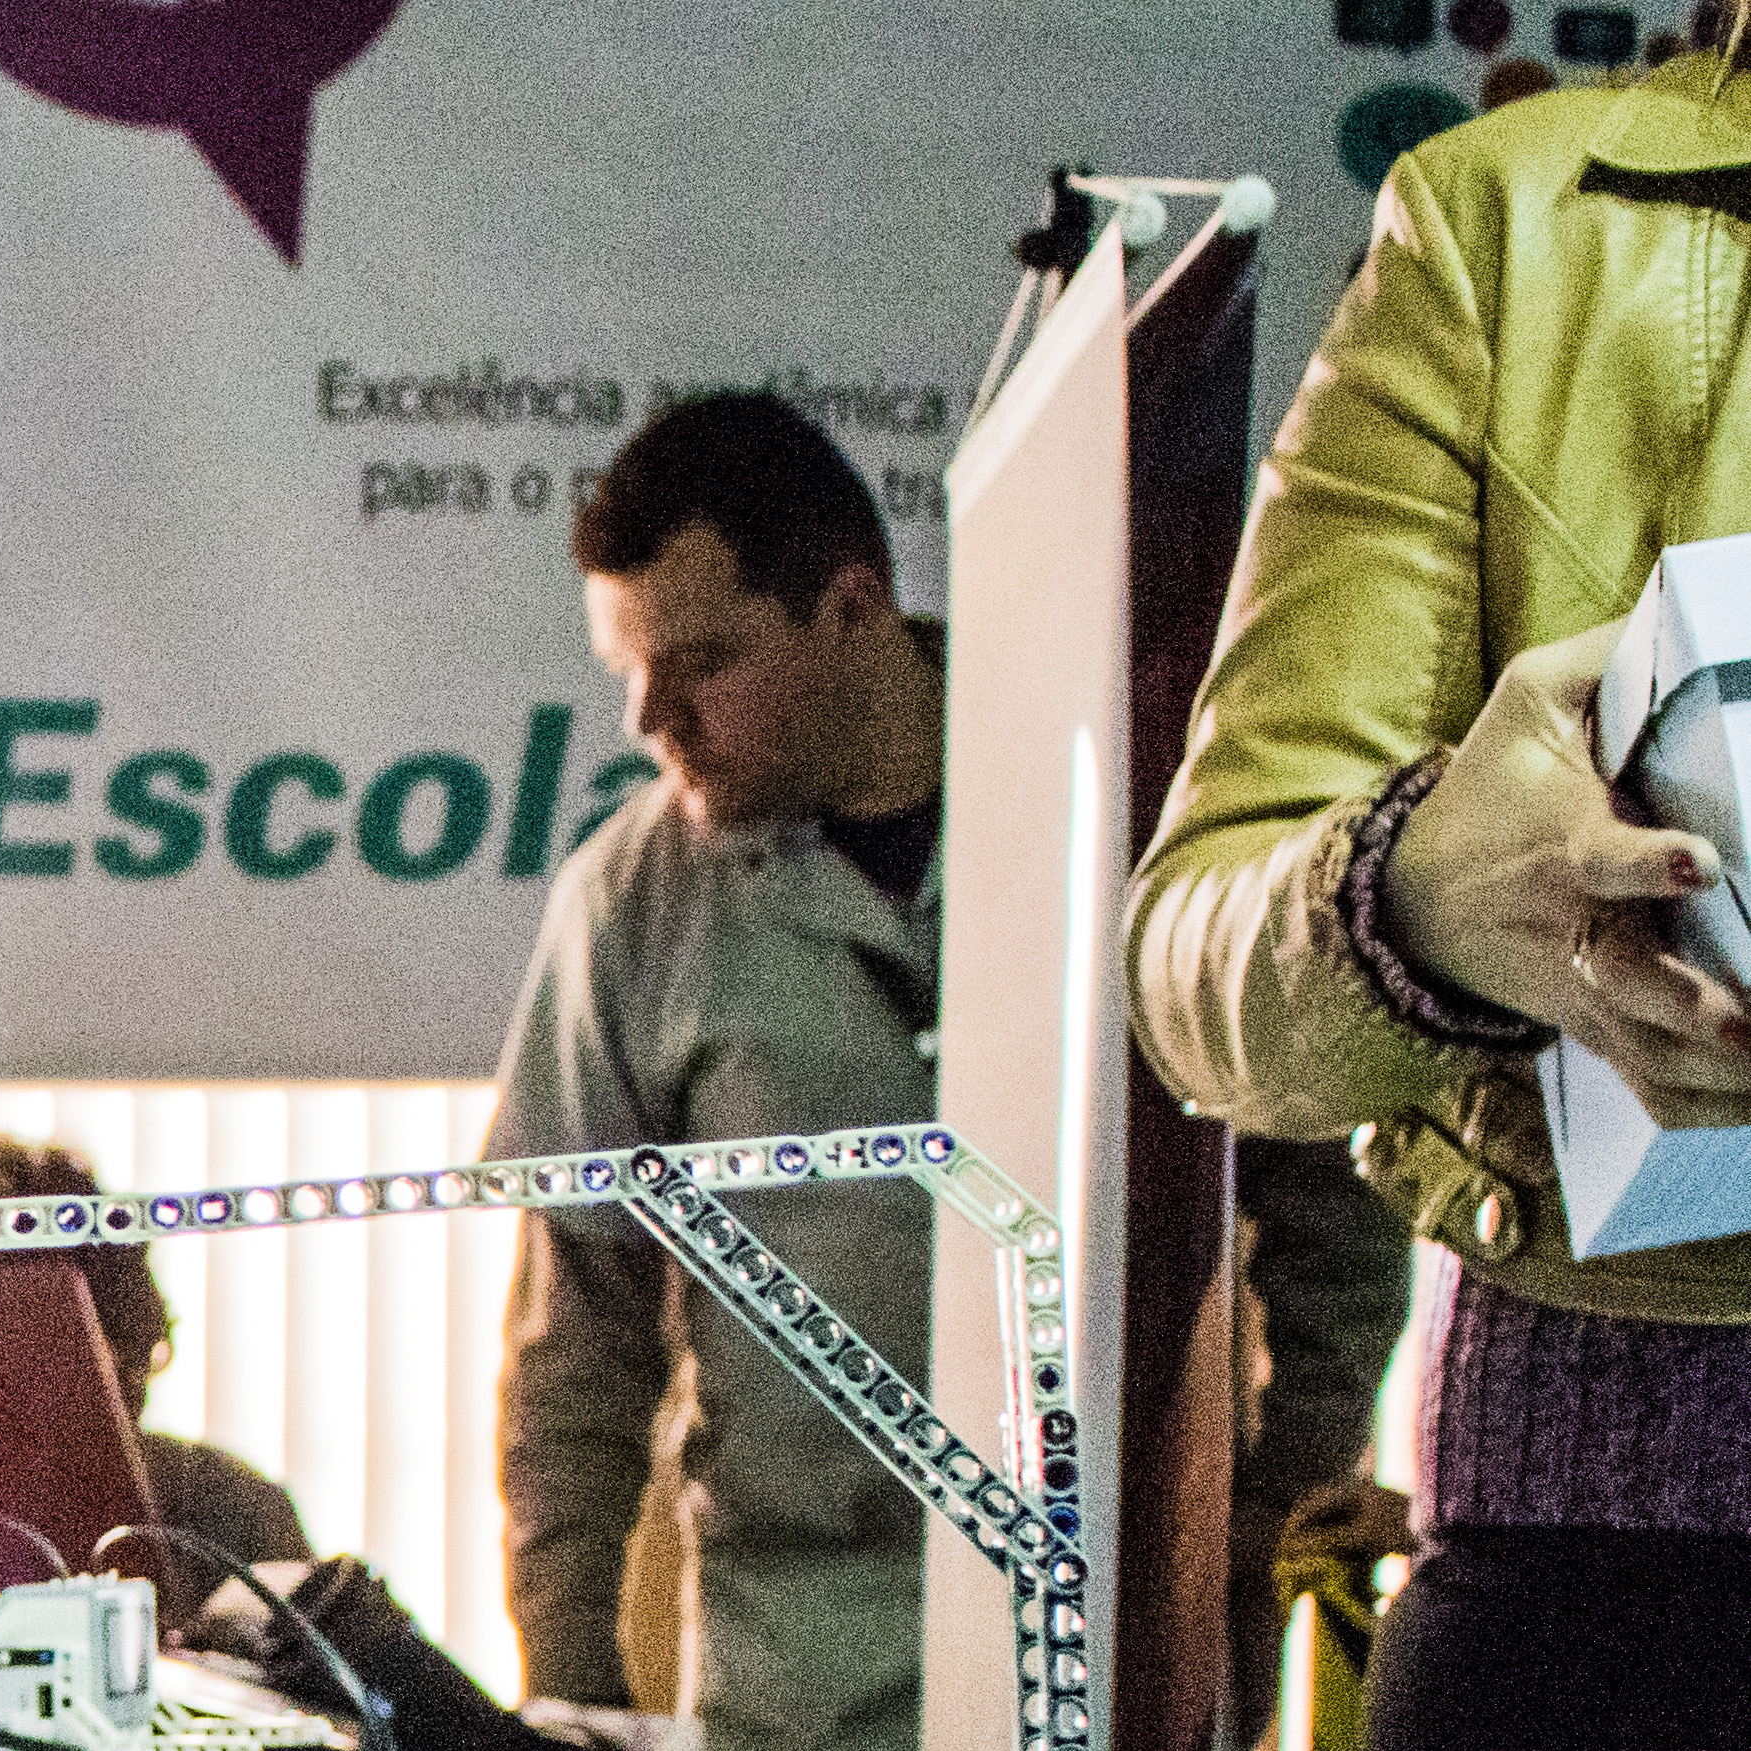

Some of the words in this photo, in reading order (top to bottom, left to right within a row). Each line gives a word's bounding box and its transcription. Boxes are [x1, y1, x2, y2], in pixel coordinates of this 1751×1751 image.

[317, 358, 627, 429] Excelência
[361, 456, 492, 521] para
[509, 462, 554, 515] o
